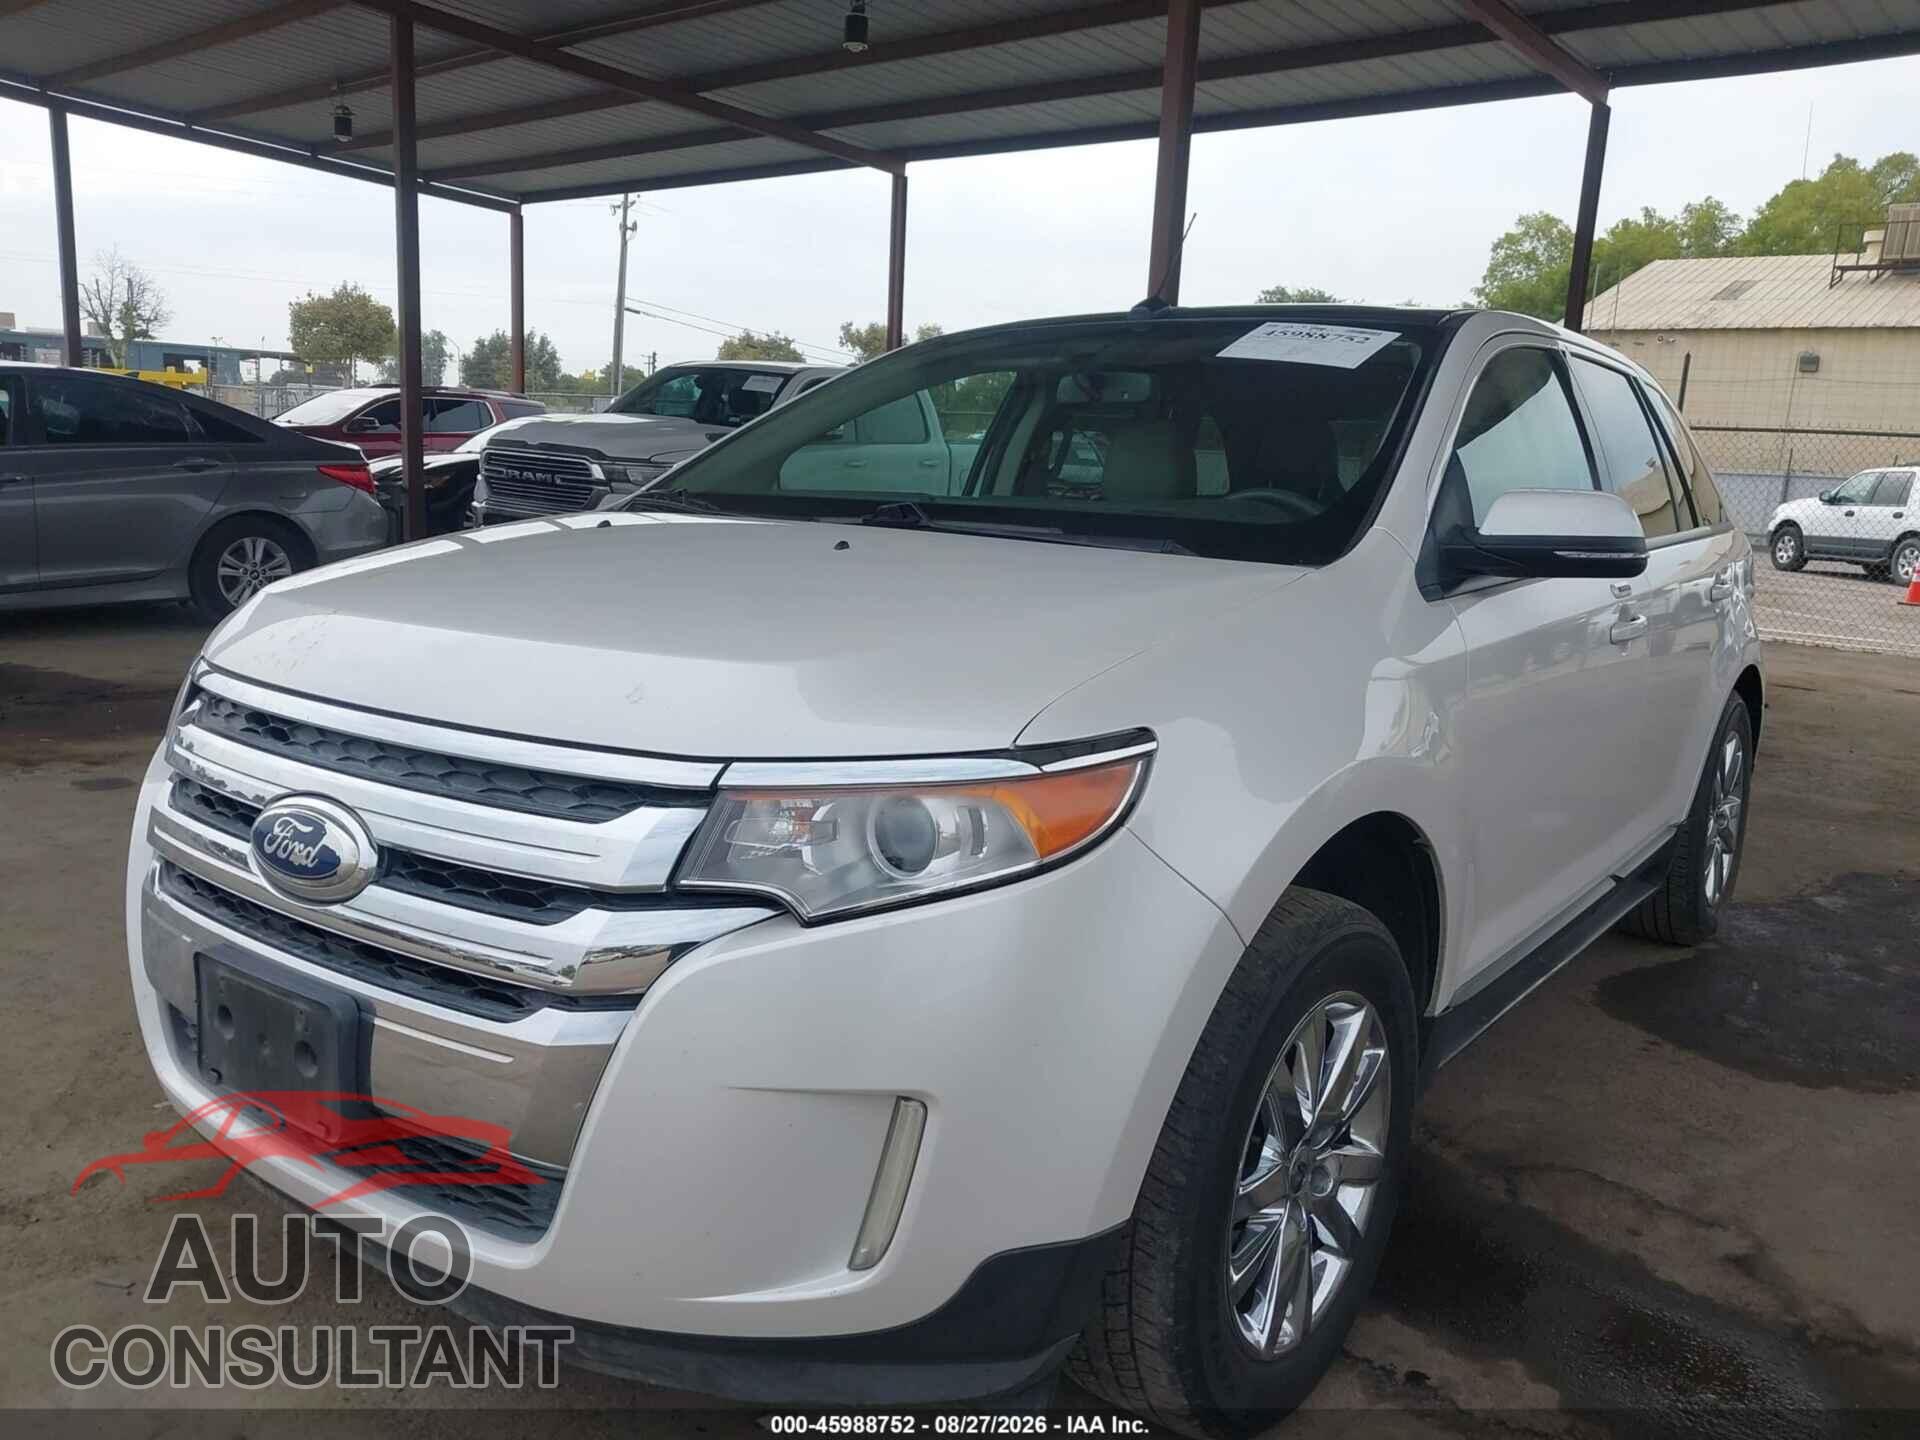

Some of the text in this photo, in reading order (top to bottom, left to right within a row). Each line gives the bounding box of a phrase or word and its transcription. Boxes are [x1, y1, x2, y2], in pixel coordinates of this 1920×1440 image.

[1264, 329, 1371, 344] 45988752
[507, 469, 553, 483] RAM
[264, 817, 324, 868] Ford
